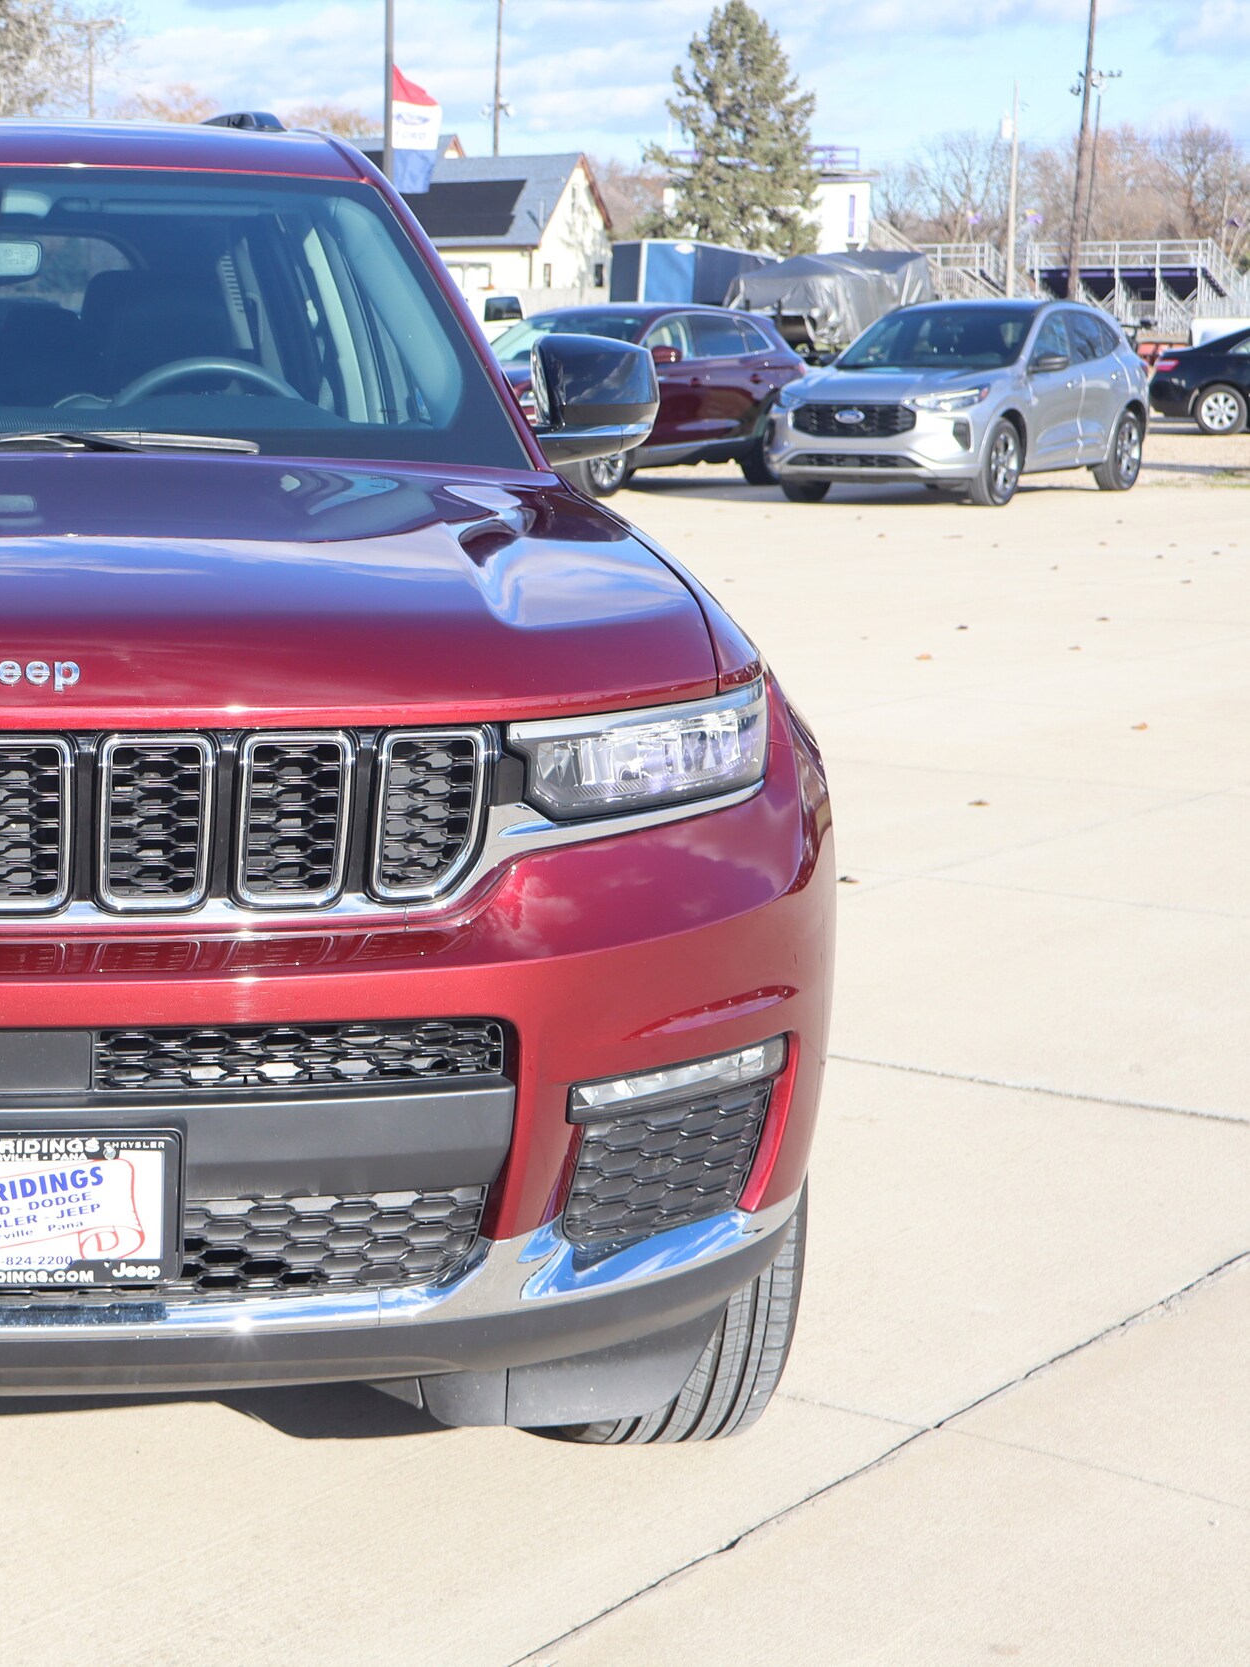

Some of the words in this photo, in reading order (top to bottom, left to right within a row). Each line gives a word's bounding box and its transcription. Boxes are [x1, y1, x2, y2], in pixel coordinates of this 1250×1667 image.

[0, 1138, 100, 1154] RIDINGS
[103, 1141, 165, 1149] CHRYSLER
[51, 1153, 88, 1161] PANA
[28, 1191, 93, 1211] DODGE
[56, 1203, 101, 1219] JEEP
[47, 1221, 84, 1232] Pana
[112, 1262, 161, 1280] Jeep
